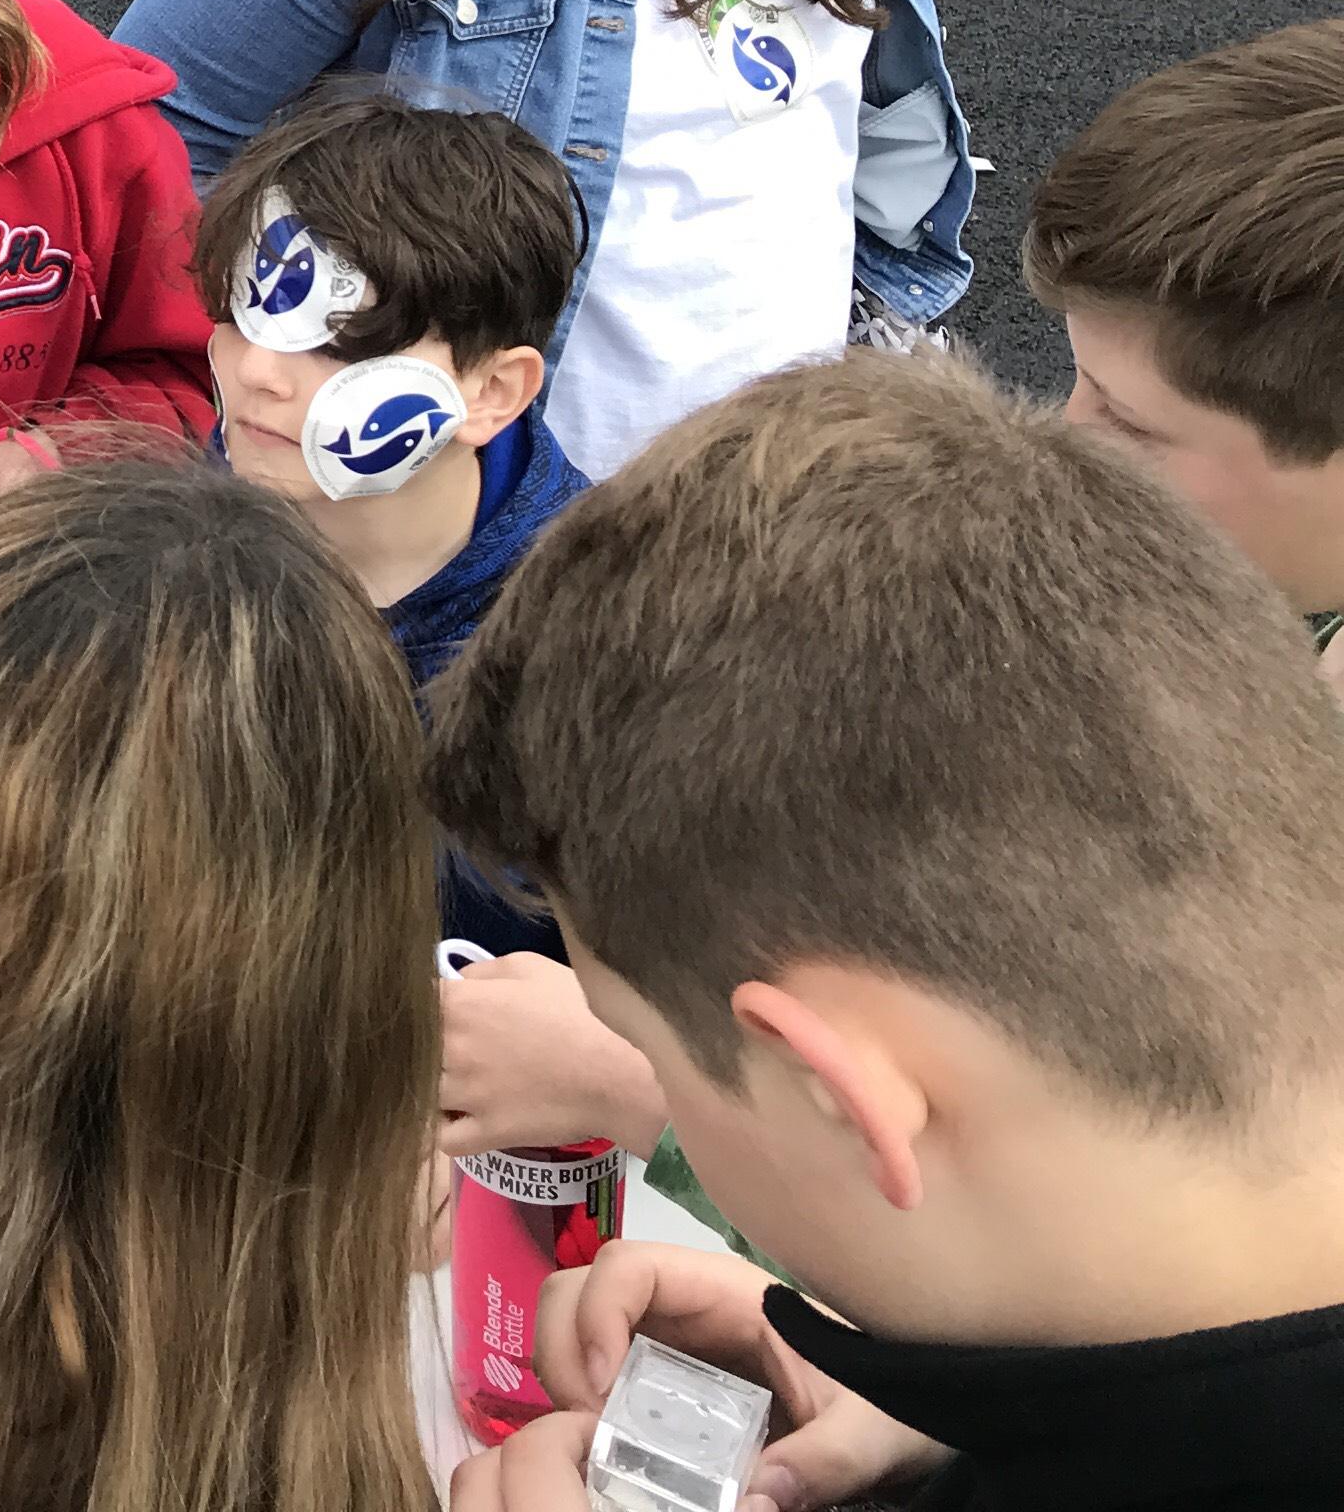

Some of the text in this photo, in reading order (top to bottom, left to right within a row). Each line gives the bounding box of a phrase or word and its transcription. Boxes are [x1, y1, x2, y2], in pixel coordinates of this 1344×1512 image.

[486, 1150, 620, 1184] WATER BOTTLE
[499, 1175, 559, 1201] MIXES
[482, 1273, 504, 1349] Blender
